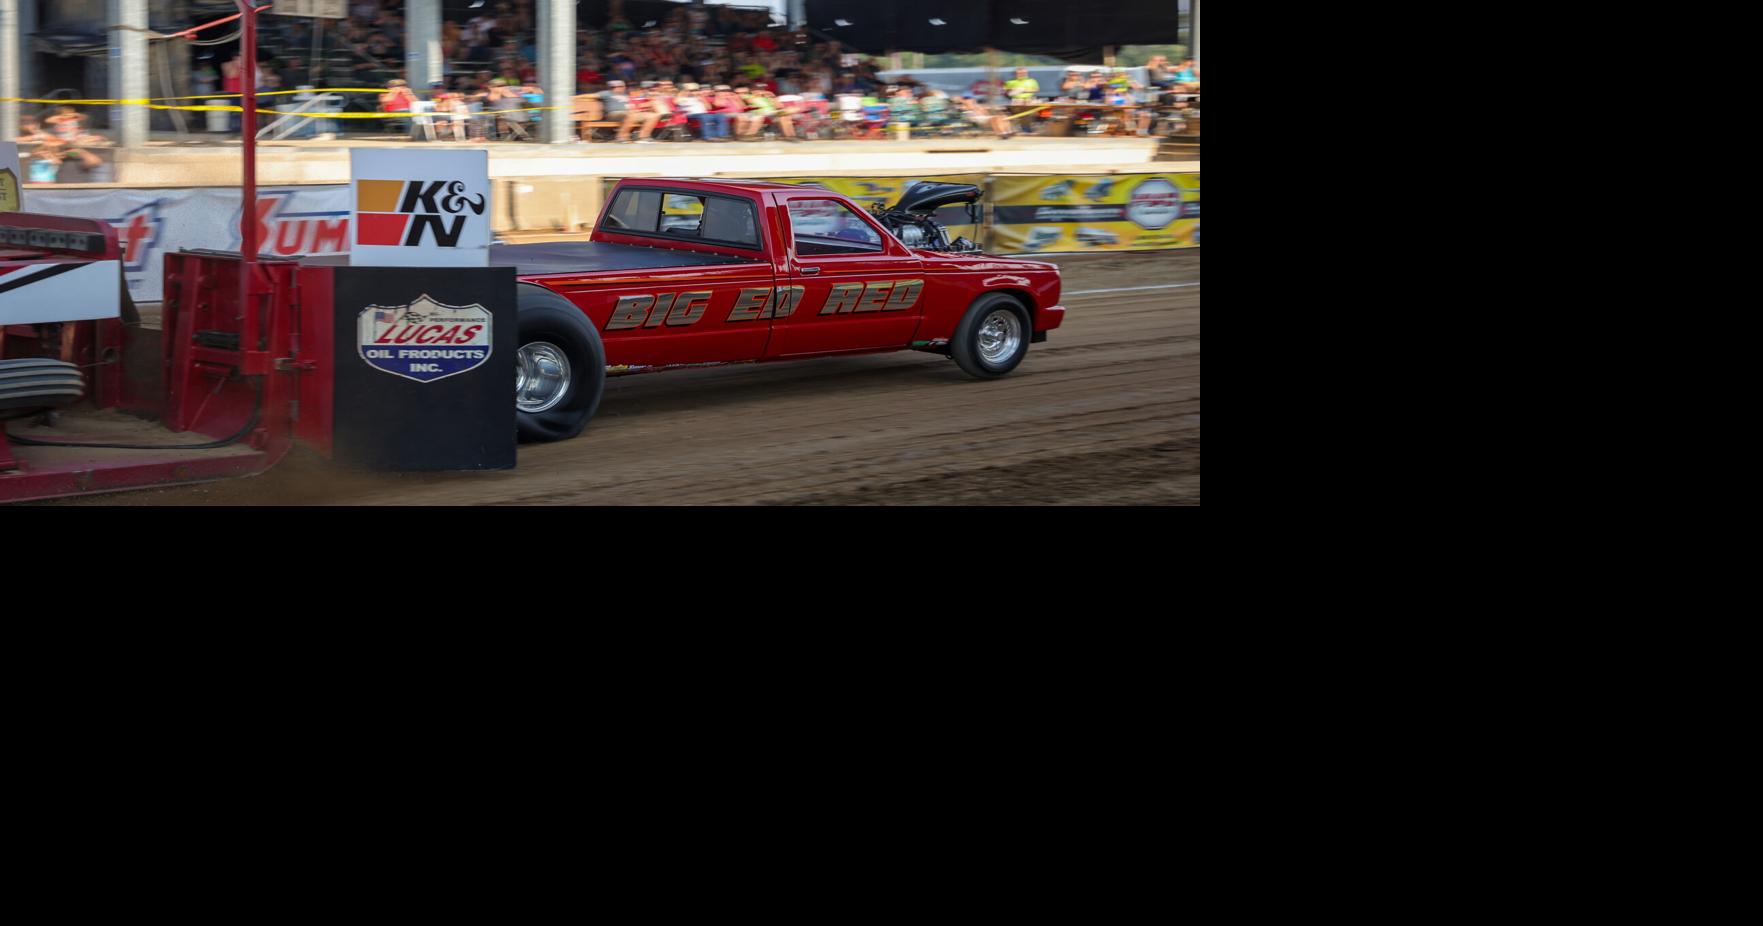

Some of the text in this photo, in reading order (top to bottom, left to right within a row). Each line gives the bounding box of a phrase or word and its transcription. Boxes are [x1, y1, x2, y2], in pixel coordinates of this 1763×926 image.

[604, 279, 924, 331] BIG ED RED
[373, 324, 483, 344] LUCAS
[366, 349, 485, 359] OIL PRODUCTS
[409, 363, 443, 372] INC.
